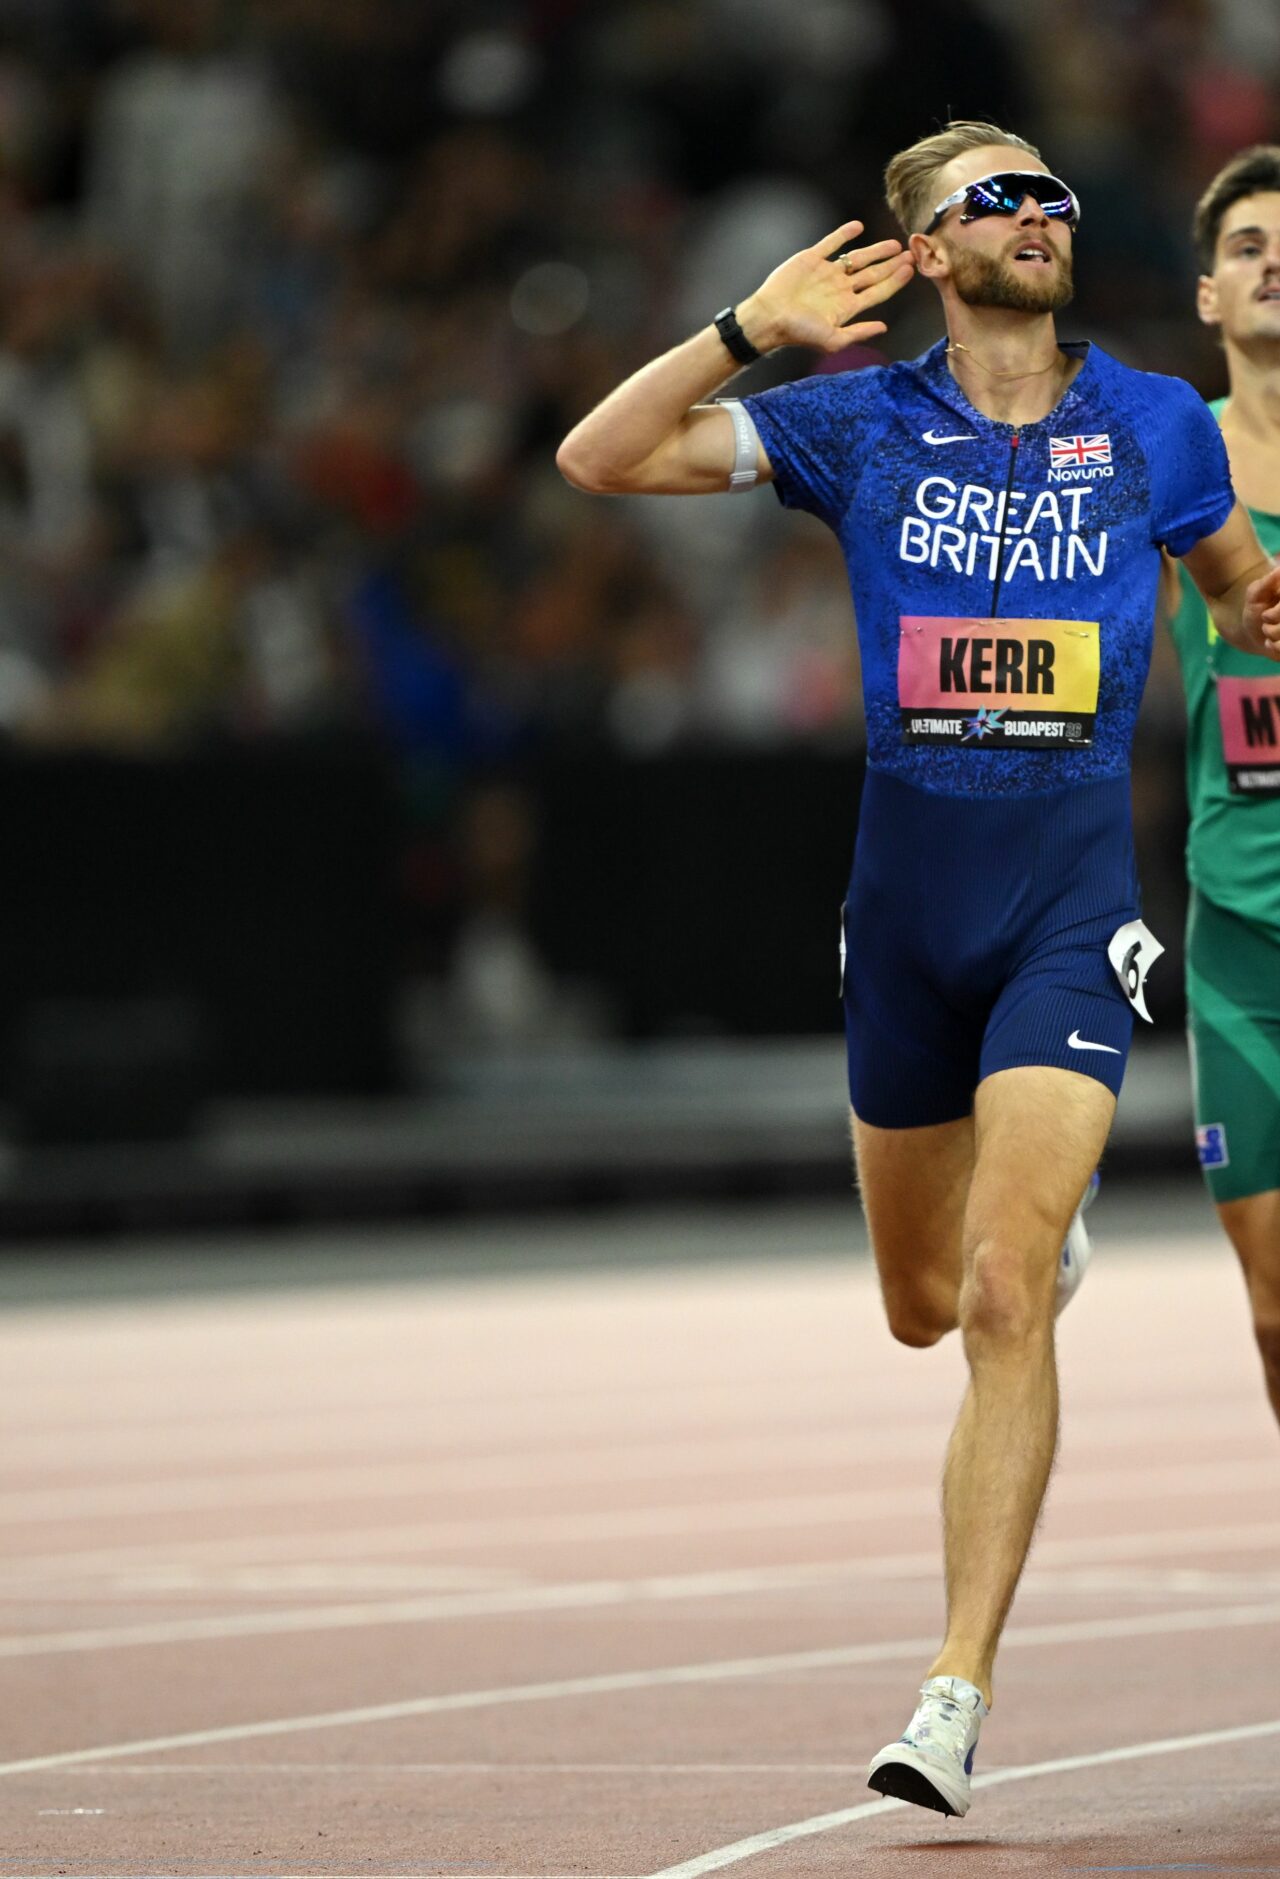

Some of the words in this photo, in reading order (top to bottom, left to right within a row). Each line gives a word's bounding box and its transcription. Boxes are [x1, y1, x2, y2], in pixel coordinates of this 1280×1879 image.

[1048, 465, 1114, 483] Novuna
[916, 476, 1093, 535] GREAT
[900, 516, 1108, 583] BRITAIN
[939, 637, 1055, 695] KERR
[911, 718, 963, 735] ULTIMATE
[1004, 720, 1066, 737] BUDAPEST
[1121, 940, 1143, 1000] 6
